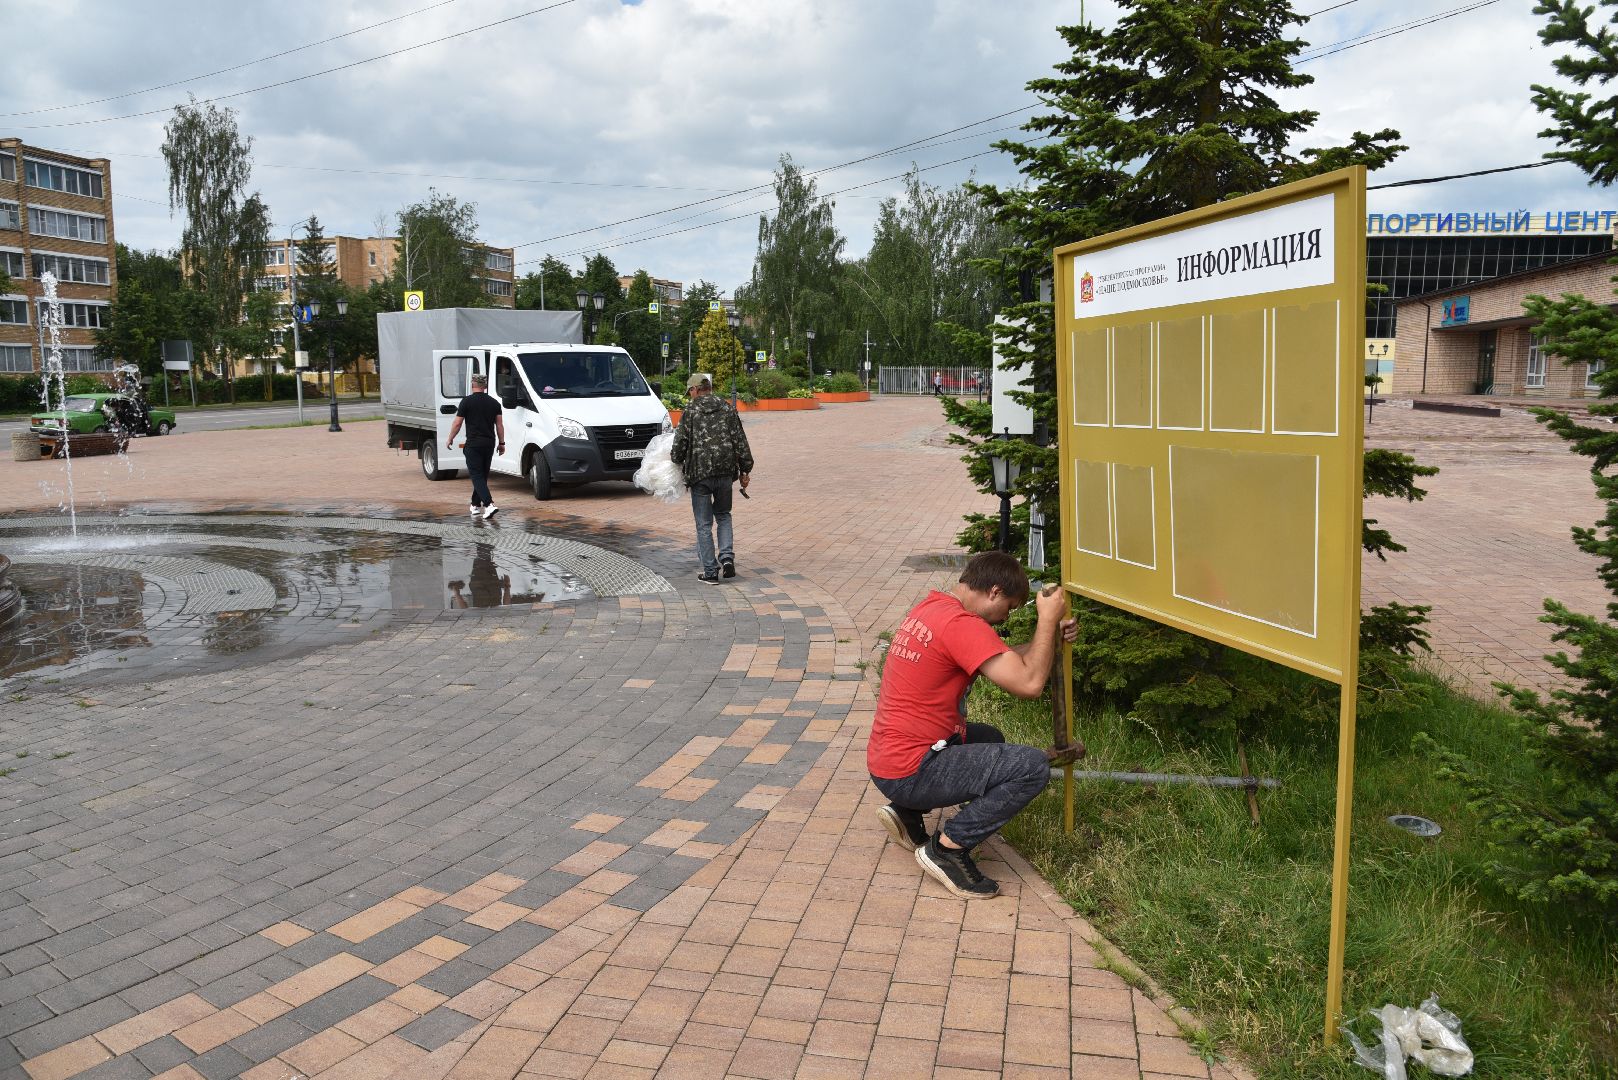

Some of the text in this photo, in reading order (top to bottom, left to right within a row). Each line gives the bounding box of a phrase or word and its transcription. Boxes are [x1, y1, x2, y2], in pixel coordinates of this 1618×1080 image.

[1367, 208, 1617, 234] ПОРТИВНЫЙ ЦЕНТ
[1176, 228, 1322, 283] ИНФОРМАЦИЯ
[1135, 263, 1166, 276] ПРОГРАММА
[1117, 274, 1169, 292] ПОДМОСКОВЬЕ»
[409, 298, 419, 306] 40
